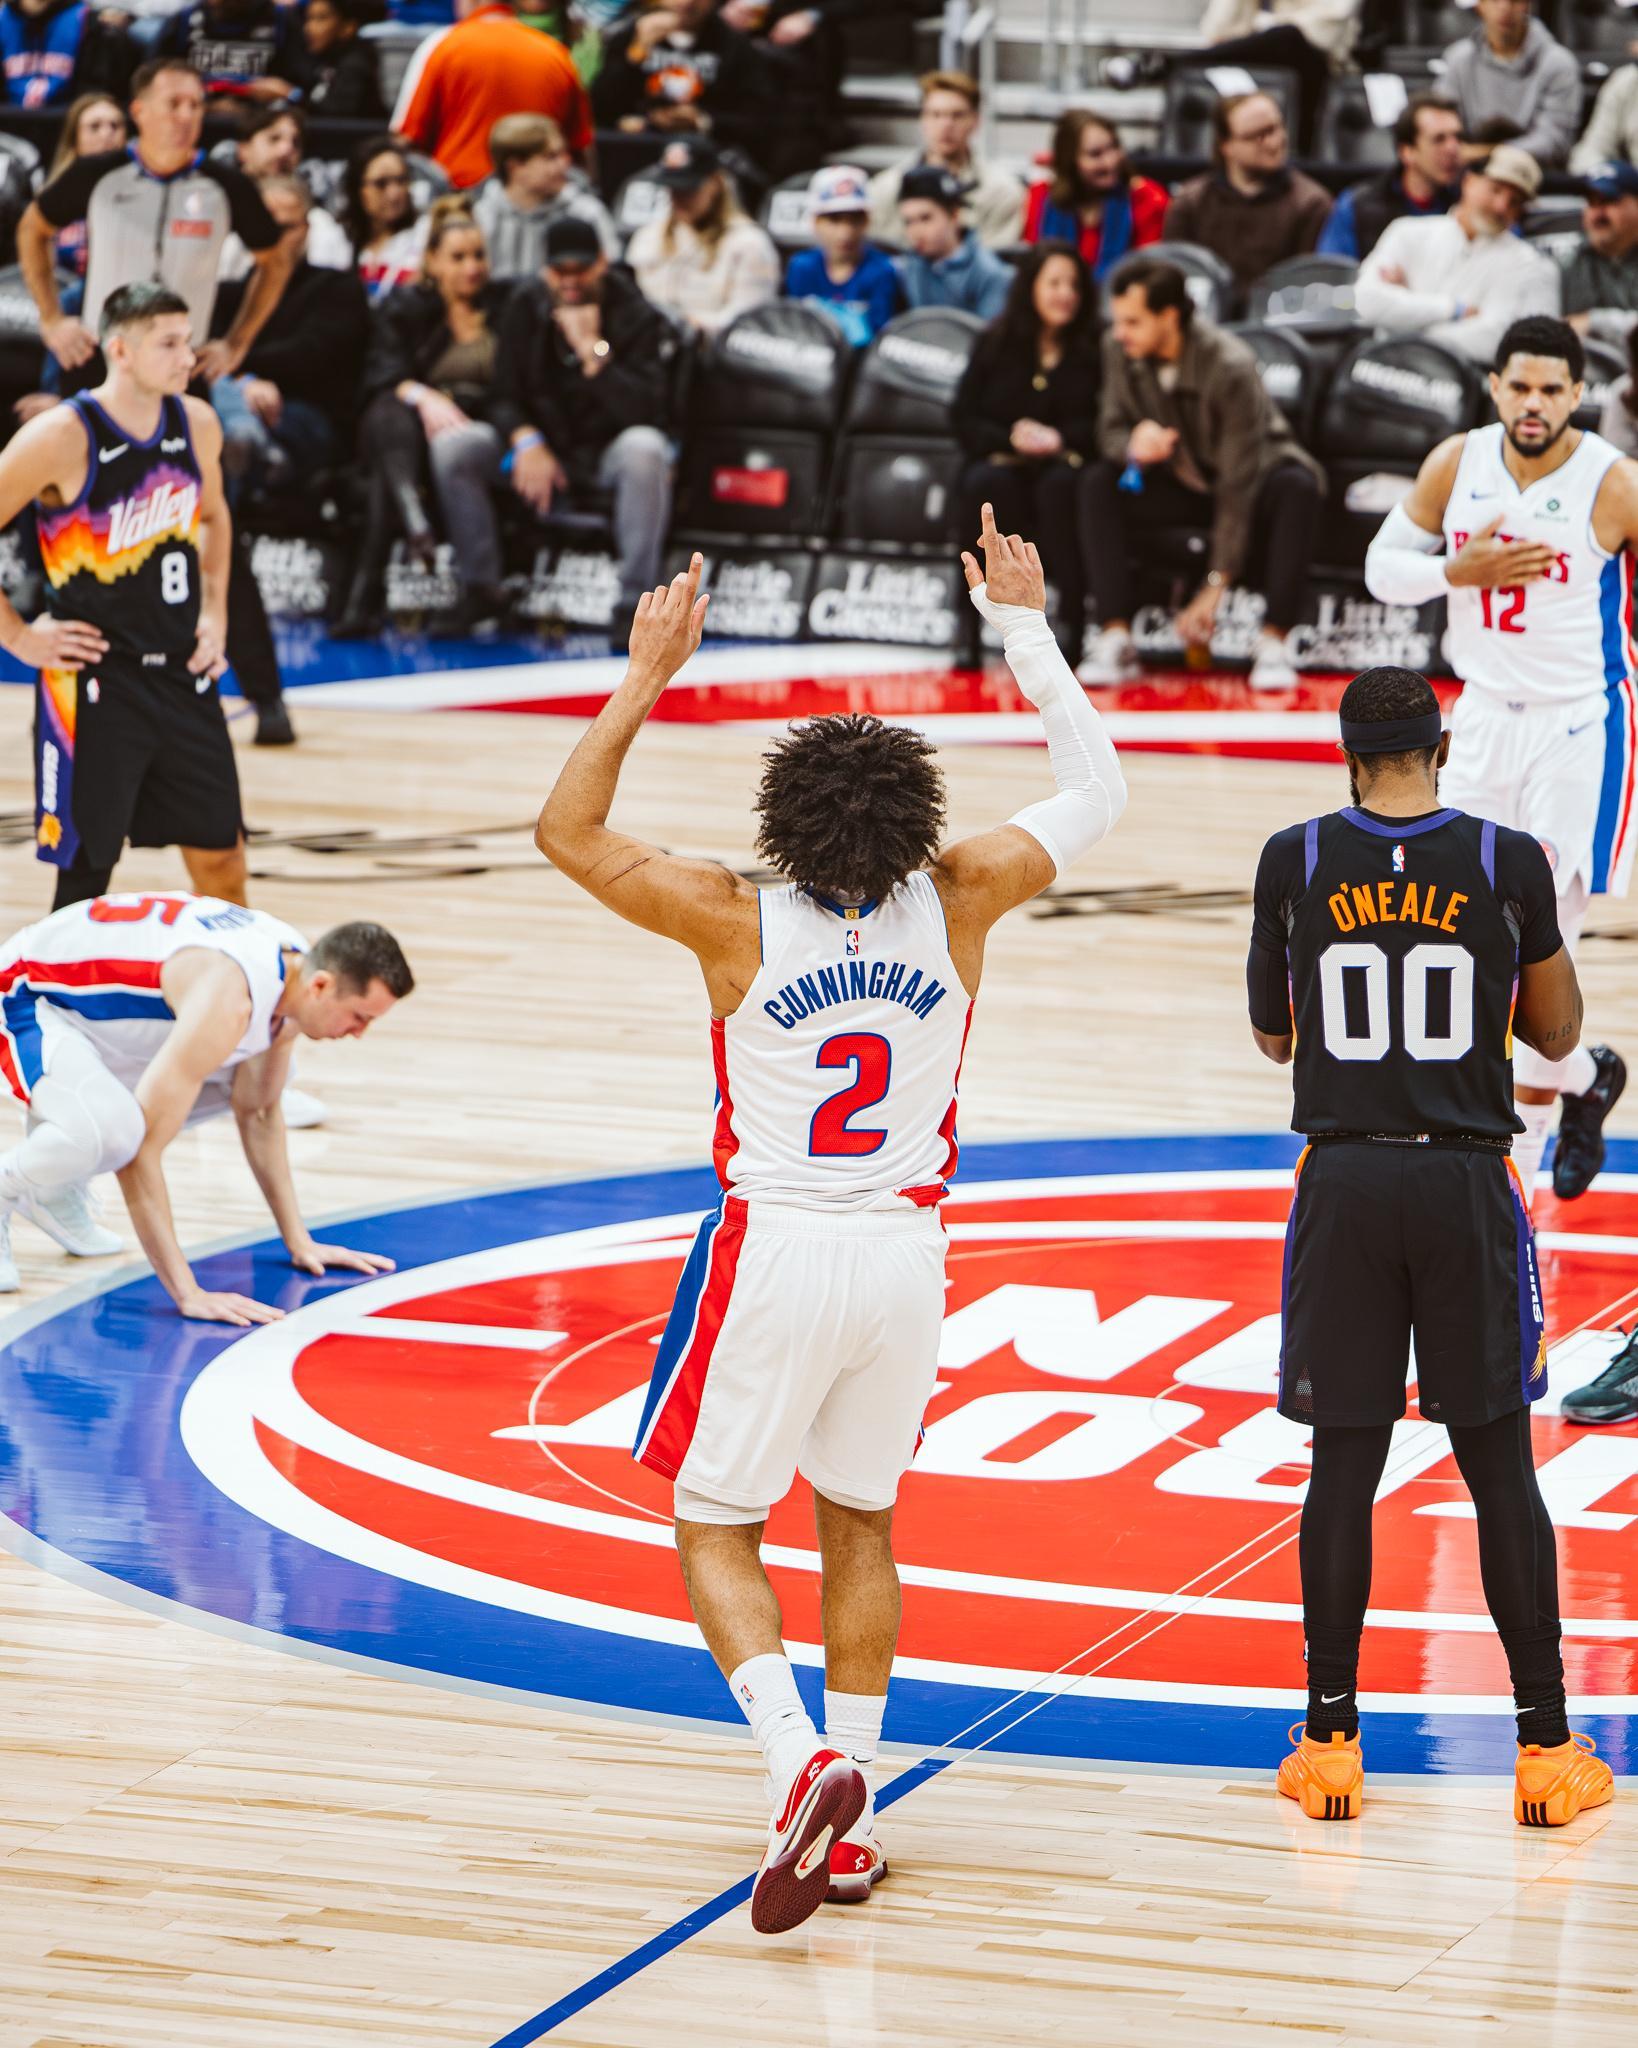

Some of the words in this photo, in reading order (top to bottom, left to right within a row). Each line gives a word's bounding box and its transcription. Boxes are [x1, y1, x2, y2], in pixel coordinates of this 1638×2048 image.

[107, 481, 197, 555] Valley
[161, 551, 189, 604] 8
[1480, 586, 1526, 633] 12
[1328, 881, 1469, 933] O'NEALE
[763, 960, 947, 1030] CUNNINGHAM
[1318, 942, 1474, 1061] 00
[808, 1032, 892, 1157] 2
